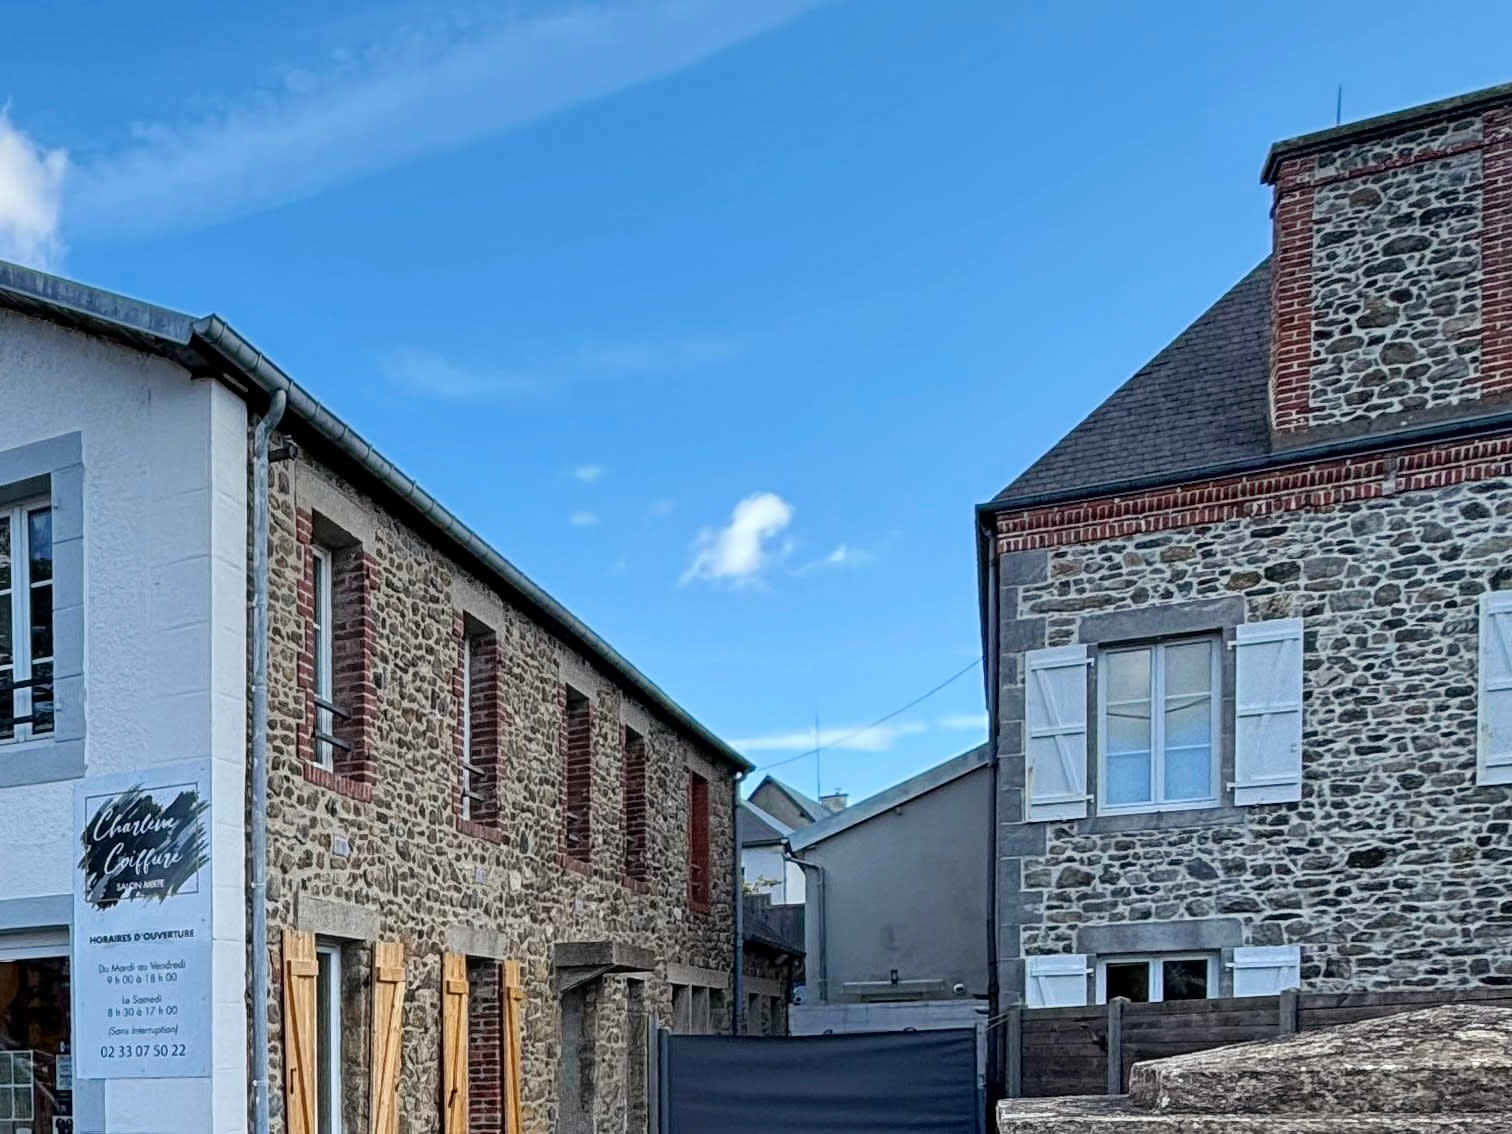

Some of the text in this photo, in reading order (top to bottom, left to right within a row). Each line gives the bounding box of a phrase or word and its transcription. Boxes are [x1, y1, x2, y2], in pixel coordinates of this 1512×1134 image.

[104, 842, 183, 875] Coiffure
[89, 929, 195, 944] HORAIRES D'OUVERTURE
[98, 964, 109, 974] Du
[122, 974, 134, 985] 00
[145, 973, 156, 984] 18
[165, 972, 177, 982] 00
[123, 1007, 134, 1018] 30
[145, 1006, 156, 1016] 17
[165, 1005, 178, 1015] 00
[100, 1043, 186, 1058] 02 33 07 50 22
